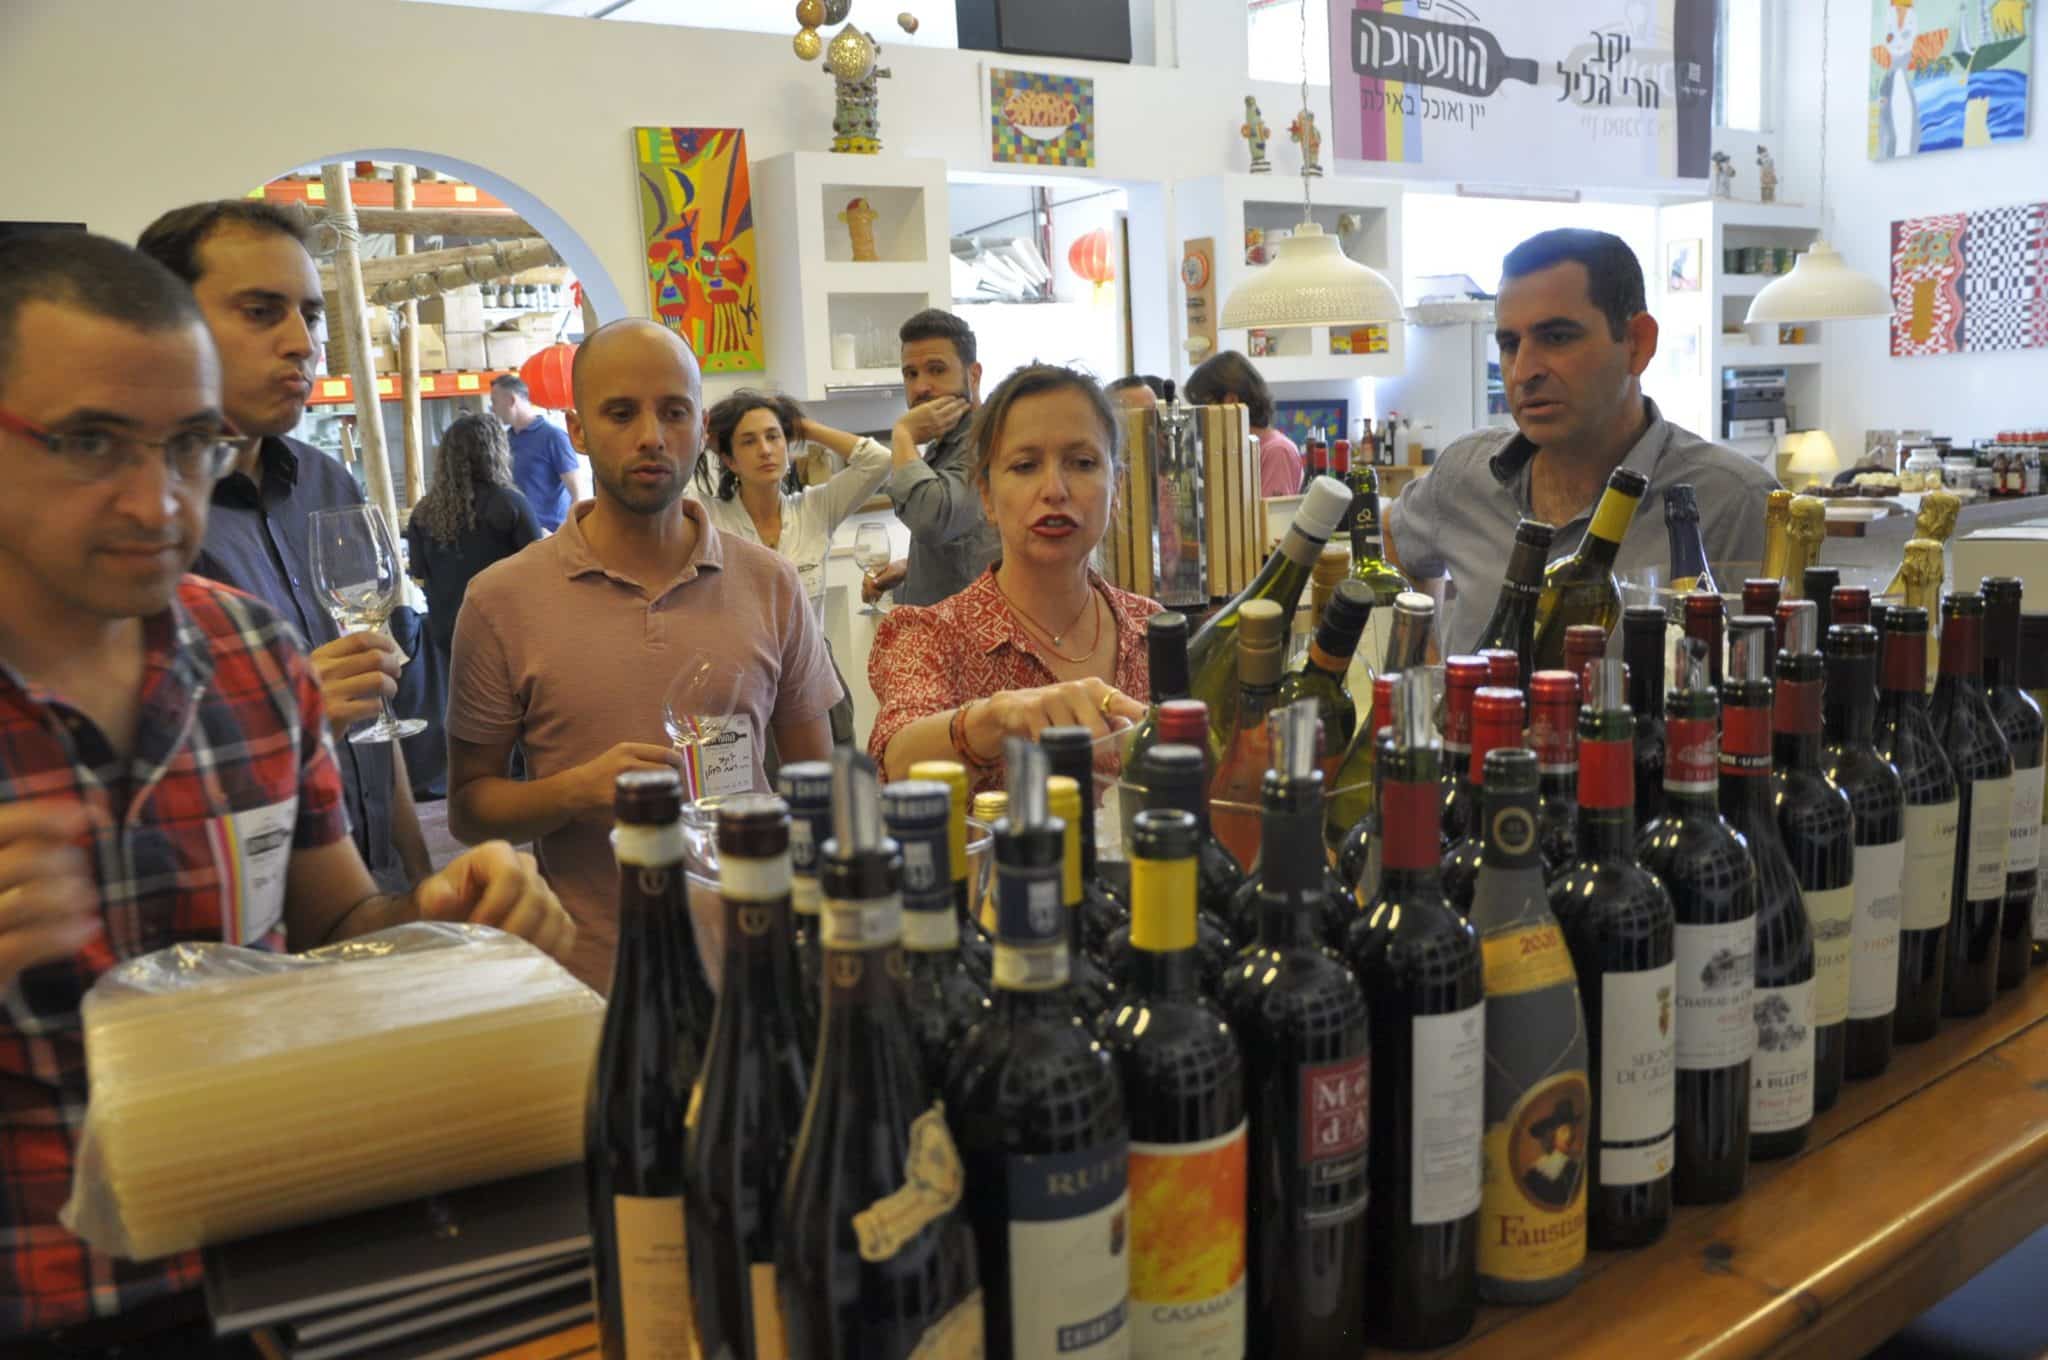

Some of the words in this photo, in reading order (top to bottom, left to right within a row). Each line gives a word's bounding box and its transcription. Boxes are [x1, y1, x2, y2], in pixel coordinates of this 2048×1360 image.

[1360, 18, 1488, 90] התערוכה
[1590, 31, 1630, 73] יקב
[1360, 77, 1415, 116] באילת
[1556, 60, 1611, 105] גליל
[1623, 77, 1659, 109] הרי
[1420, 83, 1464, 123] ואוכל
[1469, 103, 1486, 131] יין
